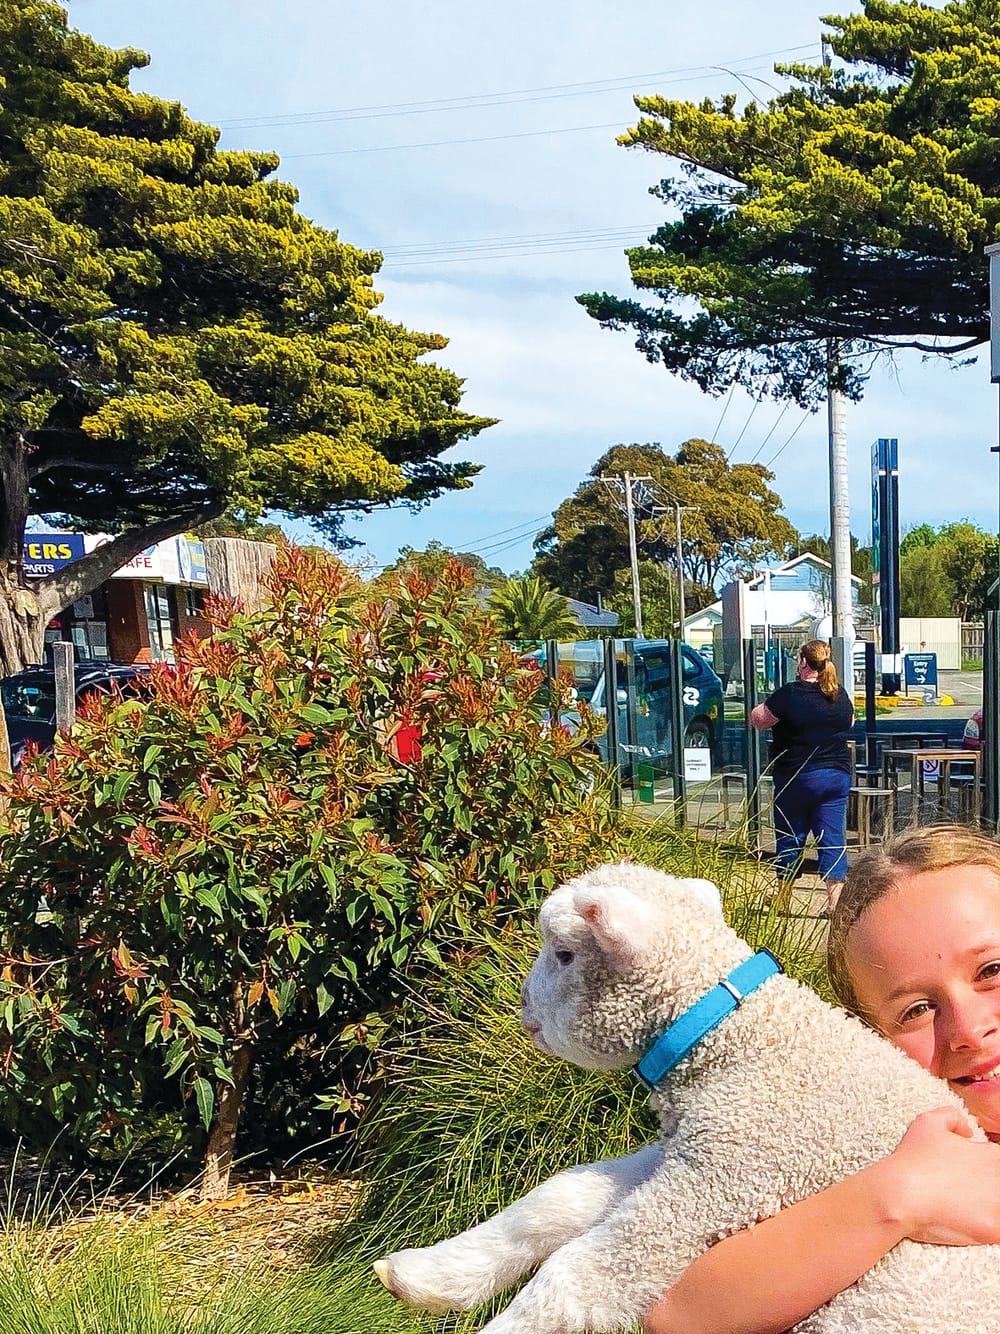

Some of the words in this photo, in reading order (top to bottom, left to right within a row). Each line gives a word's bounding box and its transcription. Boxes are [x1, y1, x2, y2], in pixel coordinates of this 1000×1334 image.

[27, 543, 72, 560] ERS
[125, 557, 153, 568] AFE
[913, 661, 928, 669] Entry
